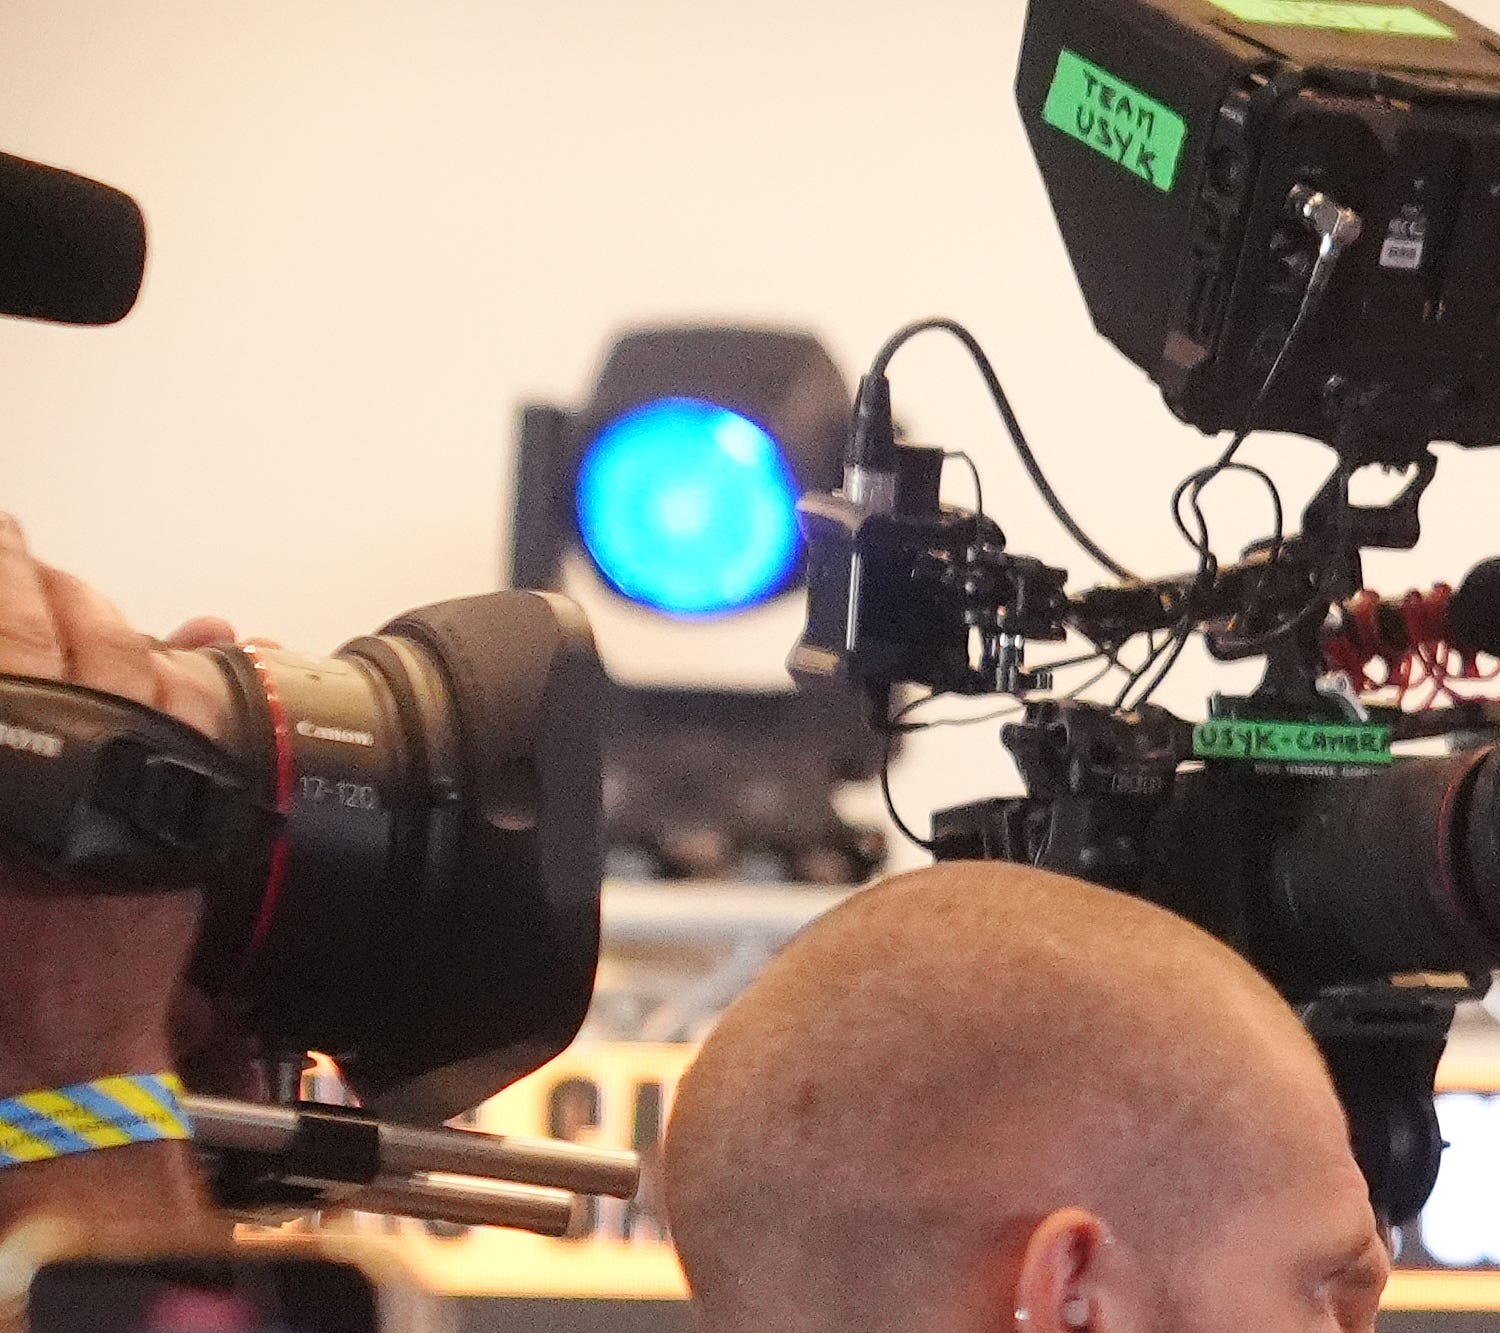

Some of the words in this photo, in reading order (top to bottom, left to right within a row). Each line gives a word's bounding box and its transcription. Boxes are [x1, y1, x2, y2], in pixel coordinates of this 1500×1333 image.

[1083, 69, 1155, 139] TEAM
[1076, 105, 1157, 181] USYK
[296, 720, 375, 747] Canon
